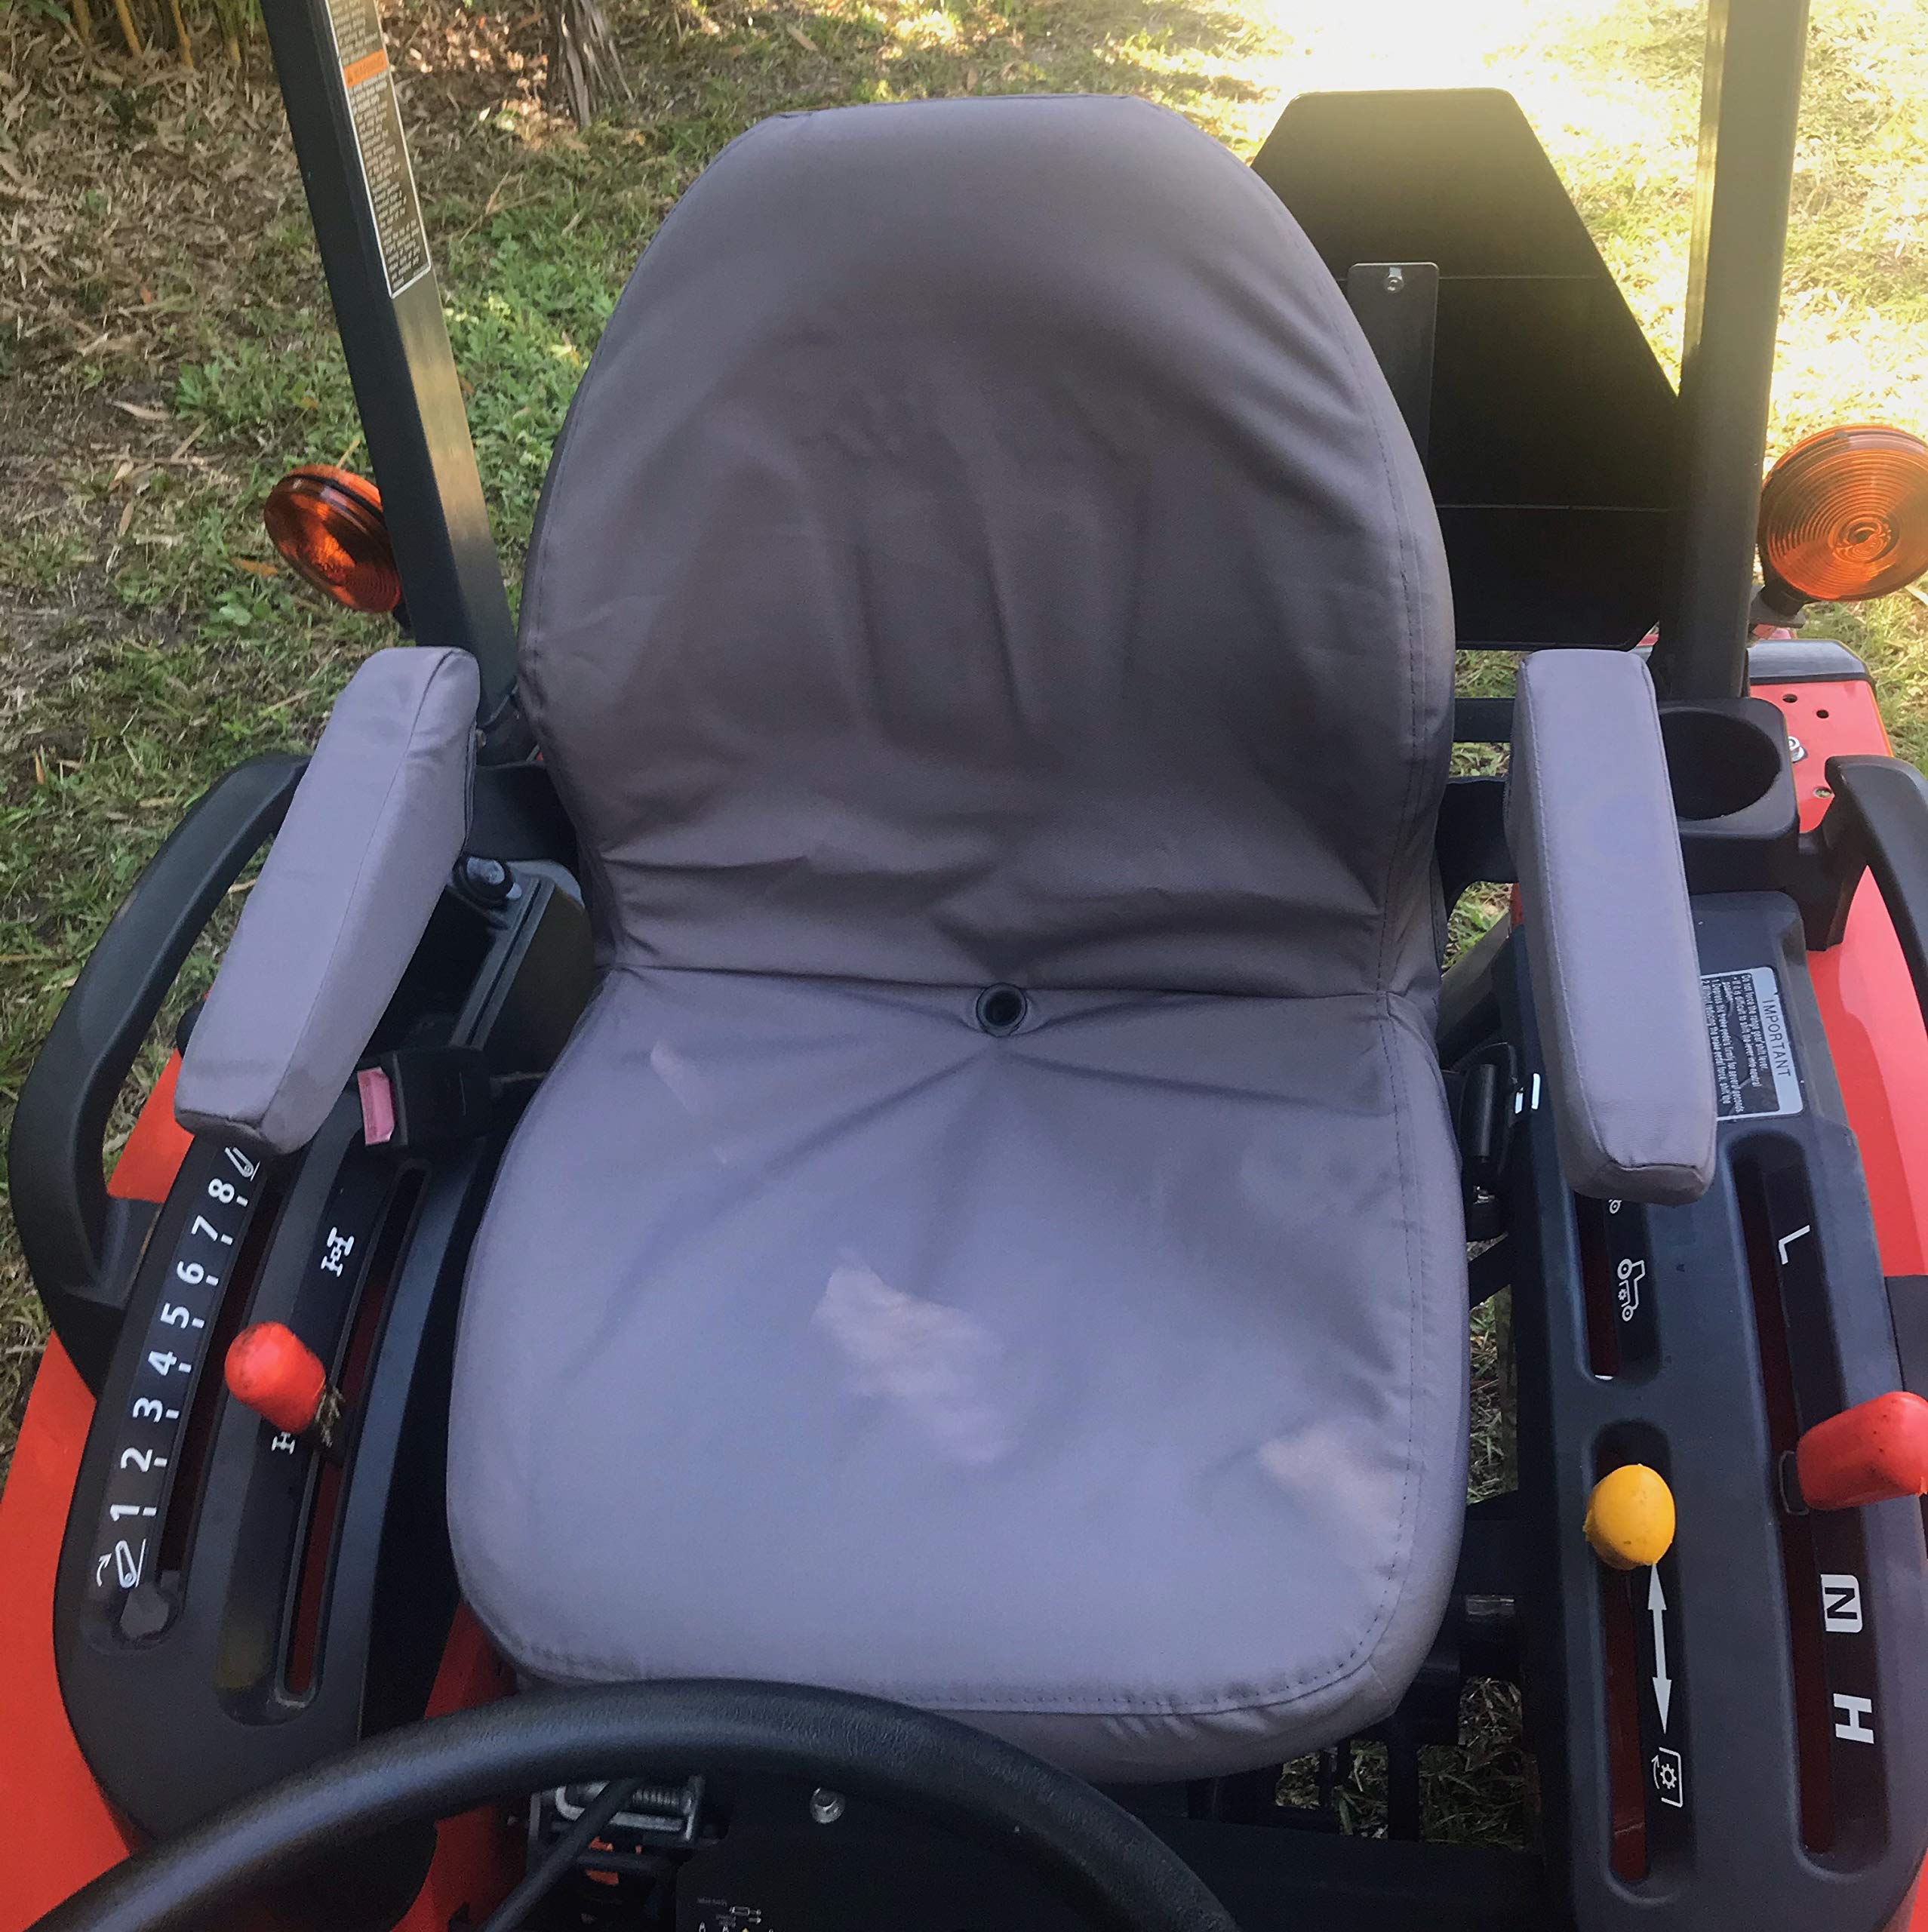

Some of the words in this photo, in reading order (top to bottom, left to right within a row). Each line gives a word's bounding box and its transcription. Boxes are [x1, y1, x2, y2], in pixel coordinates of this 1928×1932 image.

[1735, 996, 1746, 1014] difficult
[1745, 992, 1754, 1004] force
[1702, 1004, 1716, 1026] reducing
[1748, 1005, 1757, 1014] the
[1717, 1014, 1727, 1027] brake
[1740, 1022, 1751, 1033] shift
[1748, 1015, 1760, 1029] range
[1710, 1026, 1718, 1035] the
[1742, 1034, 1751, 1042] the
[1762, 999, 1791, 1077] IMPORTANT
[1711, 1036, 1721, 1050] brake
[1745, 1043, 1754, 1056] lever
[1755, 1044, 1767, 1054] shift
[1711, 1051, 1725, 1066] pedal
[1723, 1047, 1735, 1060] firmly
[1728, 1071, 1741, 1089] several
[1750, 1069, 1762, 1087] neutral
[1720, 1083, 1731, 1094] shift
[208, 1179, 234, 1203] 8
[192, 1216, 217, 1241] 7
[1779, 1225, 1810, 1264] L
[177, 1261, 204, 1284] 6
[160, 1303, 189, 1328] 5
[148, 1351, 177, 1376] 4
[133, 1398, 162, 1422] 3
[121, 1447, 152, 1472] 2
[110, 1504, 140, 1521] 1
[1823, 1586, 1858, 1620] N
[1834, 1694, 1874, 1743] H
